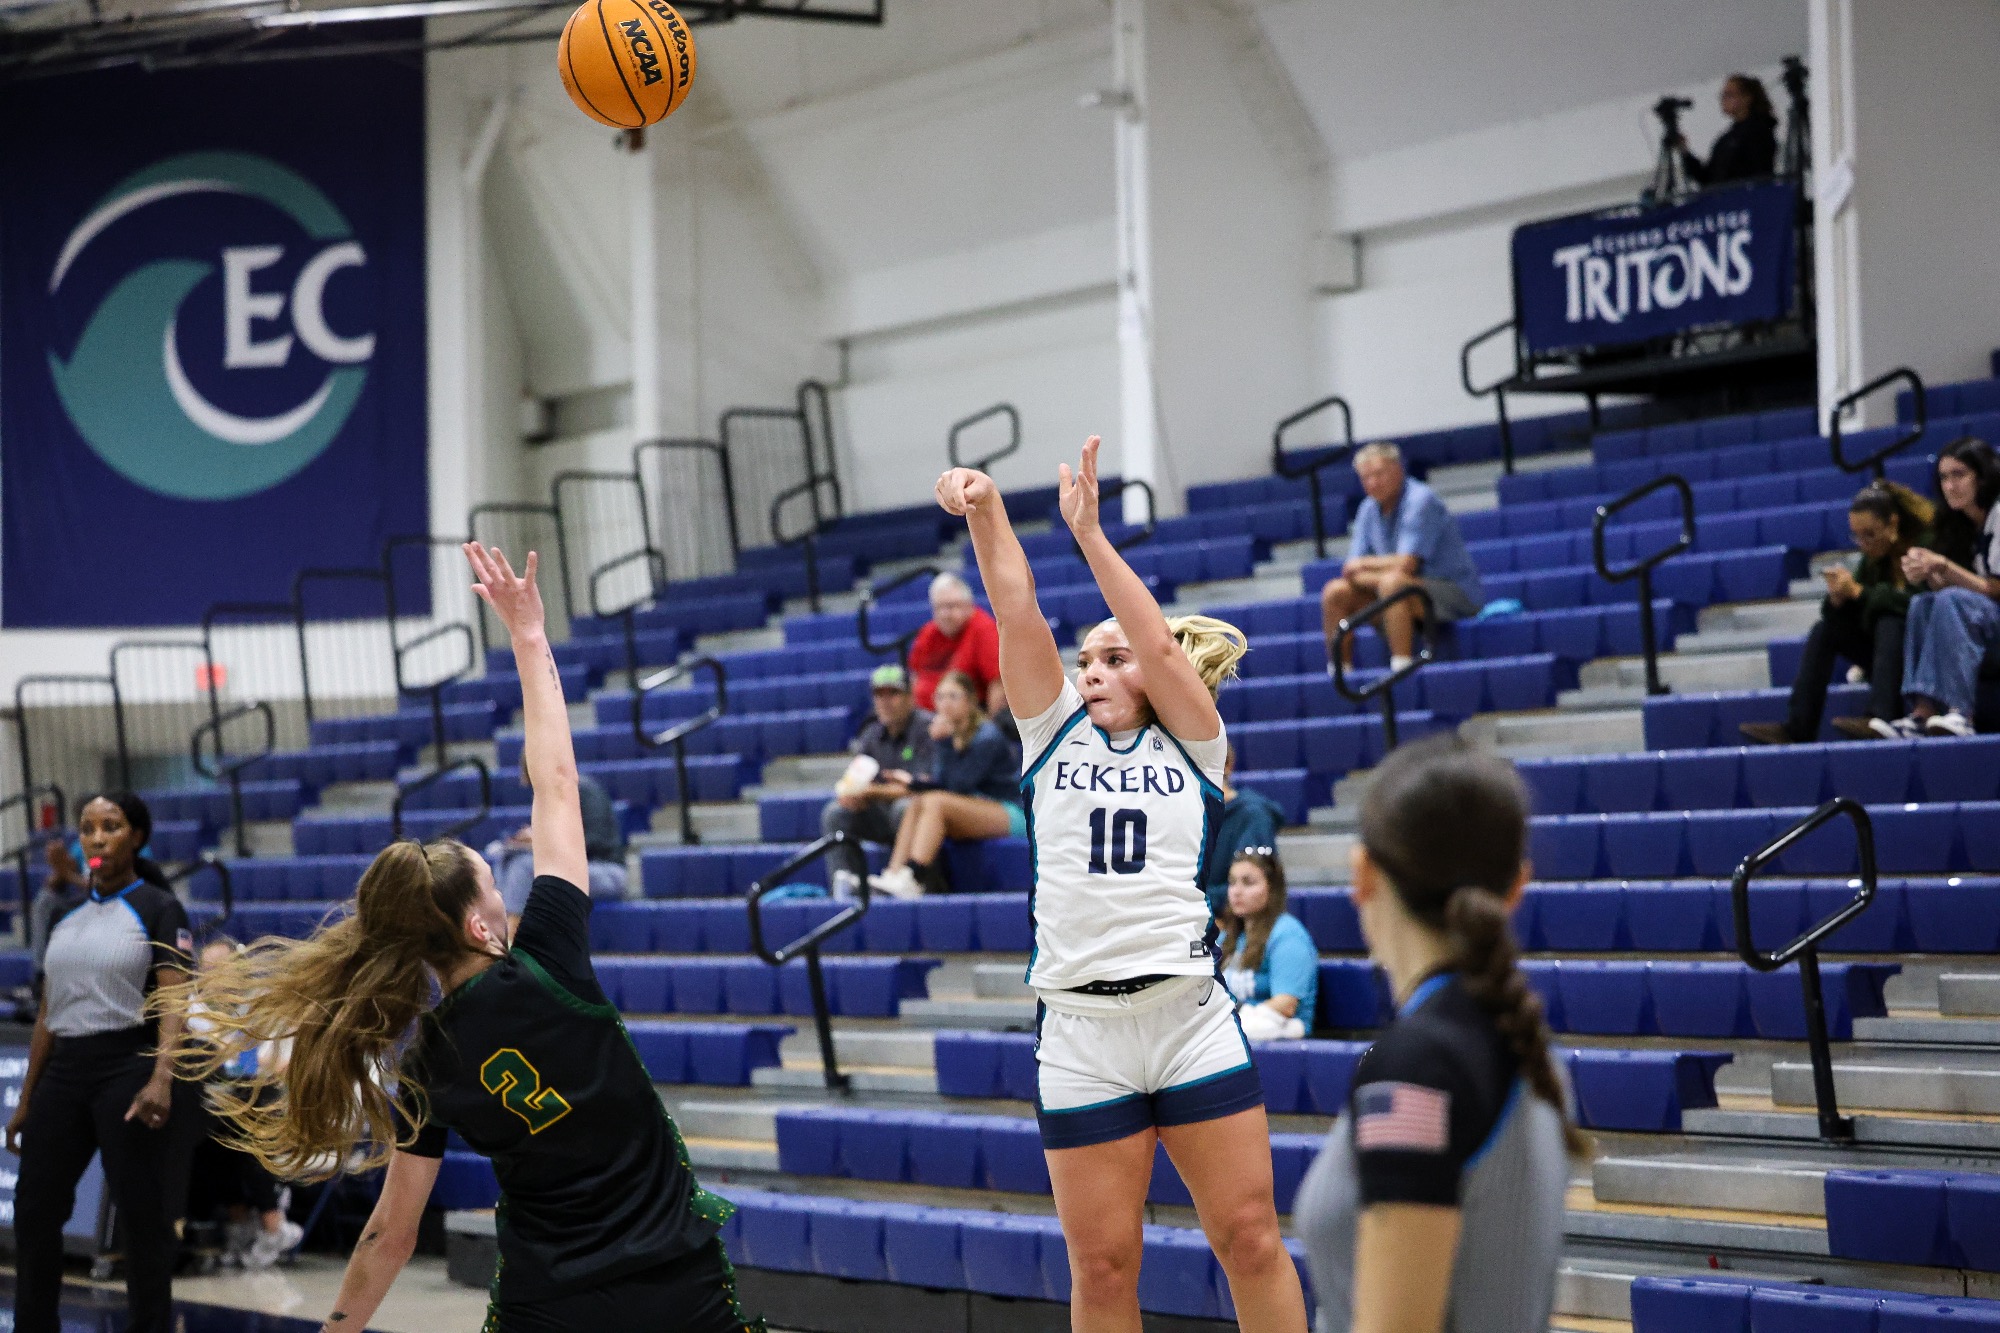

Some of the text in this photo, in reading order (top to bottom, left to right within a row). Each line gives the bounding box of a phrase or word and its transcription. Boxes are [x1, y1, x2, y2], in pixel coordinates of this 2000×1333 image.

[618, 18, 663, 86] NCAA
[221, 240, 377, 369] EC
[1552, 229, 1753, 323] TRITONS
[1054, 761, 1185, 796] ECKERD
[1088, 807, 1147, 875] 10
[480, 1047, 573, 1135] 2
